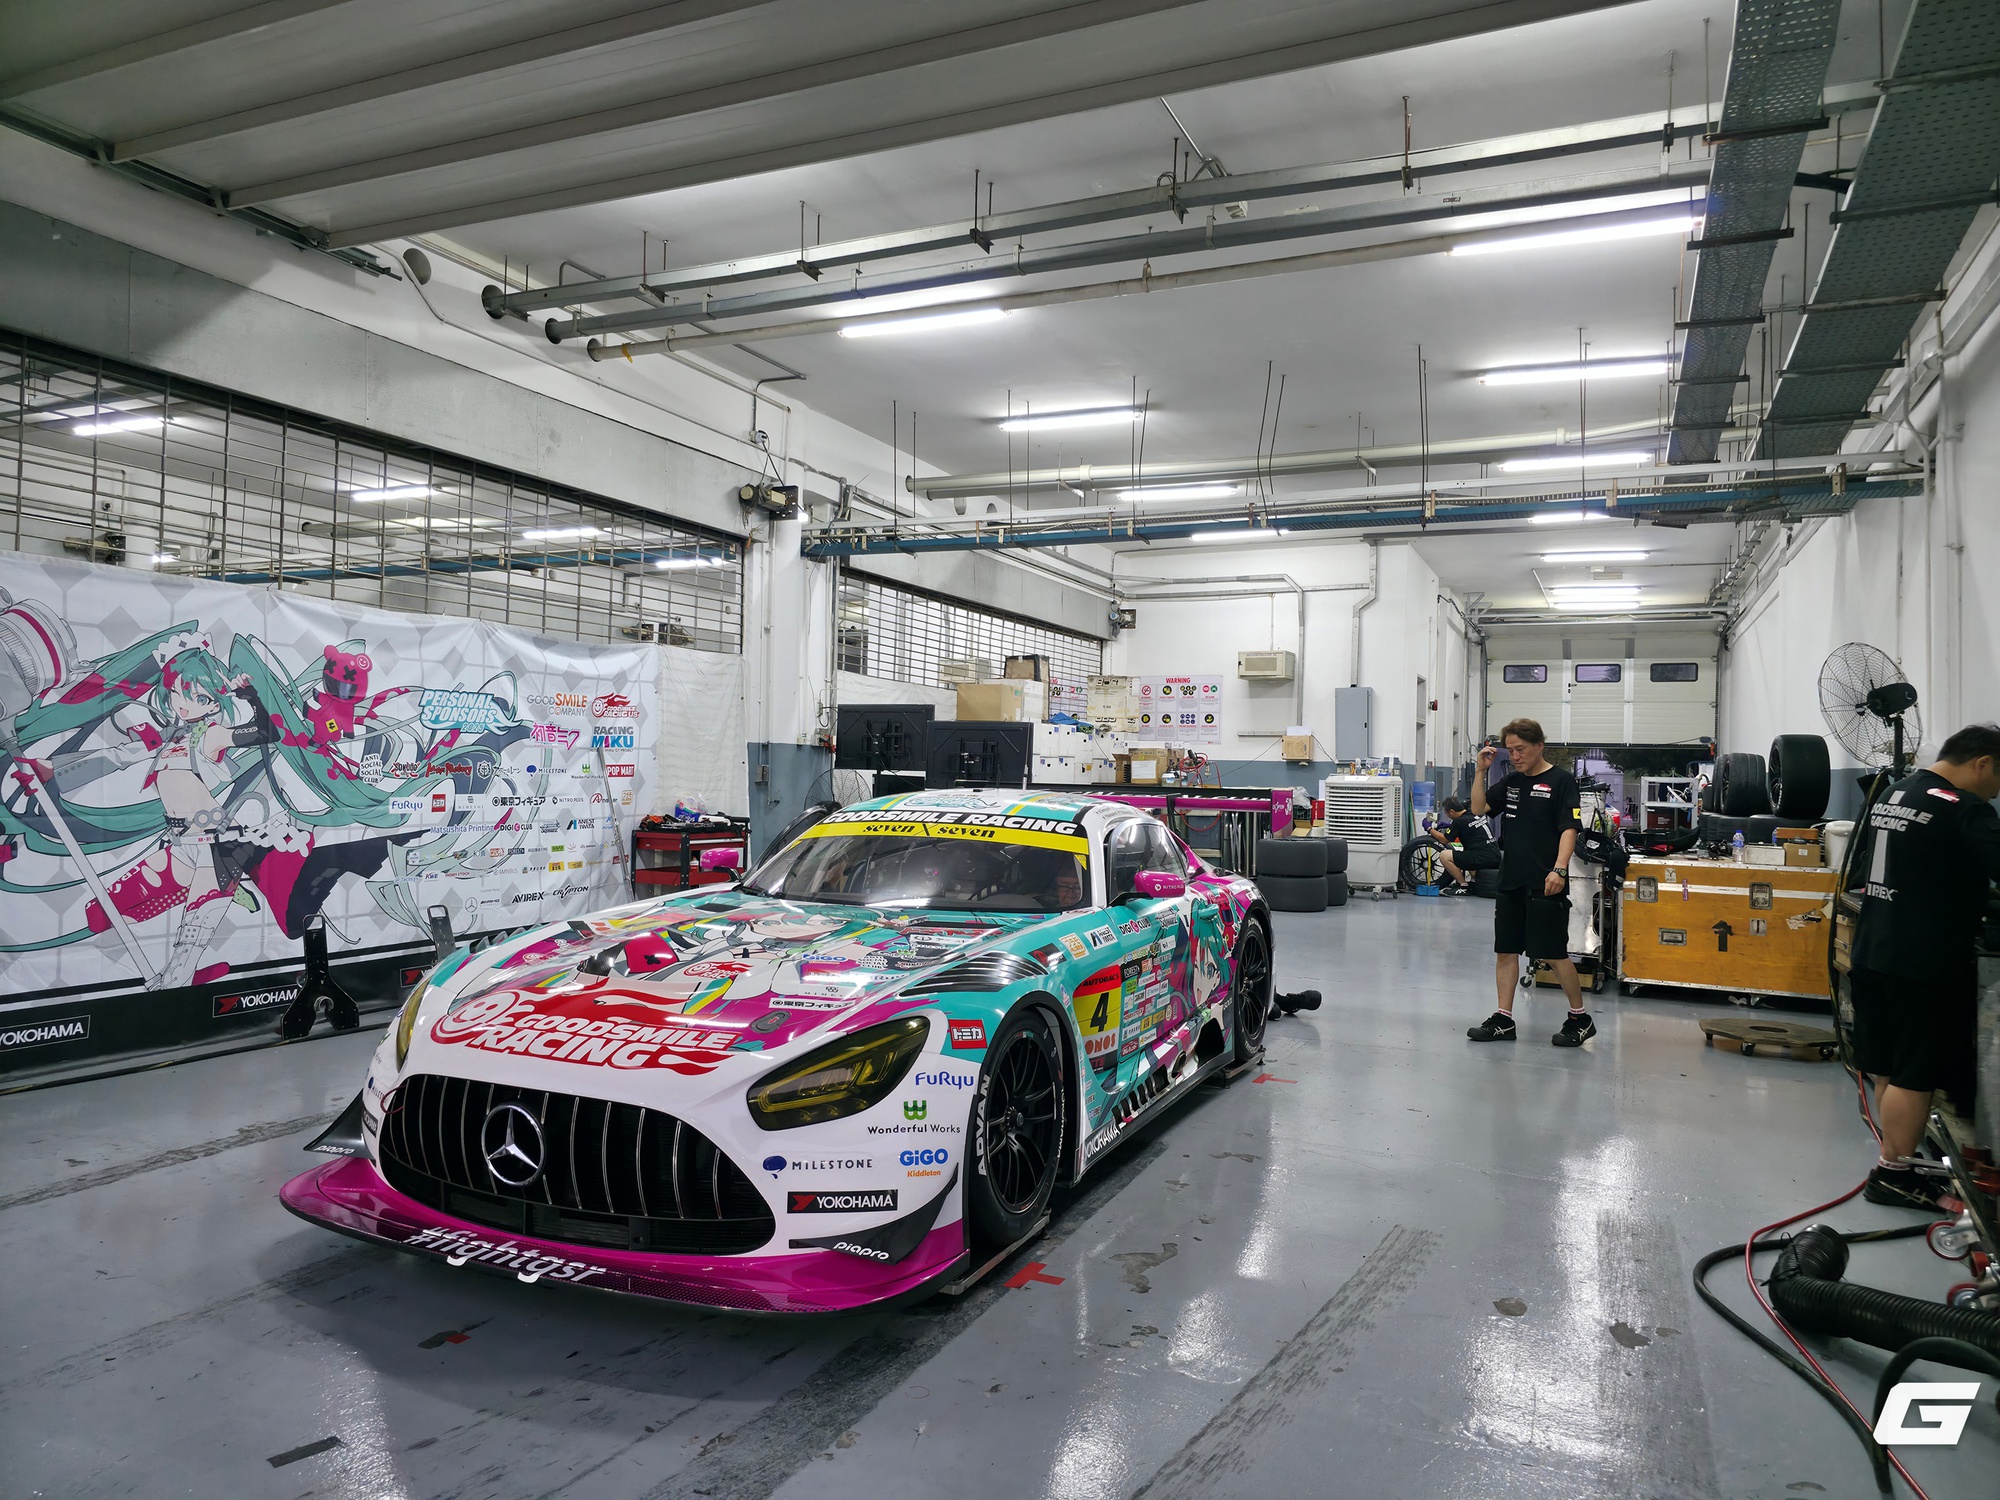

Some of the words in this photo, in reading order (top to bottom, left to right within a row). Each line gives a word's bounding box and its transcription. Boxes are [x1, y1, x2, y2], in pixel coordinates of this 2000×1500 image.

[420, 689, 493, 709] PERSONAL
[421, 706, 498, 724] SPONSORS
[548, 706, 586, 717] COMPANY
[460, 722, 486, 733] 2025
[594, 726, 634, 735] RACING
[530, 722, 580, 750] 初音ミク
[591, 735, 634, 749] MIKU
[361, 761, 381, 769] SOCIAL
[607, 766, 620, 776] POP
[620, 766, 634, 776] MART
[391, 800, 423, 811] FuRyu
[500, 796, 546, 806] 東京フィギュア
[1871, 802, 1934, 825] ODSMILE
[431, 825, 467, 834] Matsushita
[468, 825, 494, 833] Printing
[824, 811, 961, 824] GOODSMILE
[968, 813, 1078, 835] RACING
[862, 824, 916, 833] seven
[937, 825, 996, 839] seven
[512, 891, 545, 904] AVIREX
[1866, 883, 1899, 902] IREX
[1083, 973, 1119, 987] AUTOBACS
[240, 988, 298, 1008] YOKOHAM
[1090, 992, 1109, 1032] 4
[523, 1013, 736, 1050] GOODSMILE
[952, 1026, 983, 1041] トミカ
[470, 1026, 658, 1067] RACING
[915, 1071, 974, 1090] FuRyu
[867, 1124, 927, 1135] Wonderful
[930, 1124, 961, 1134] Works
[975, 1074, 991, 1177] ADVAN
[313, 1145, 356, 1155] piapro
[900, 1148, 949, 1167] GiGO
[792, 1158, 873, 1171] MILESTONE
[907, 1169, 941, 1178] Kiddleton
[816, 1194, 894, 1210] YOKOHAMA
[403, 1226, 608, 1284] #fightgsr
[833, 1241, 890, 1261] piapro
